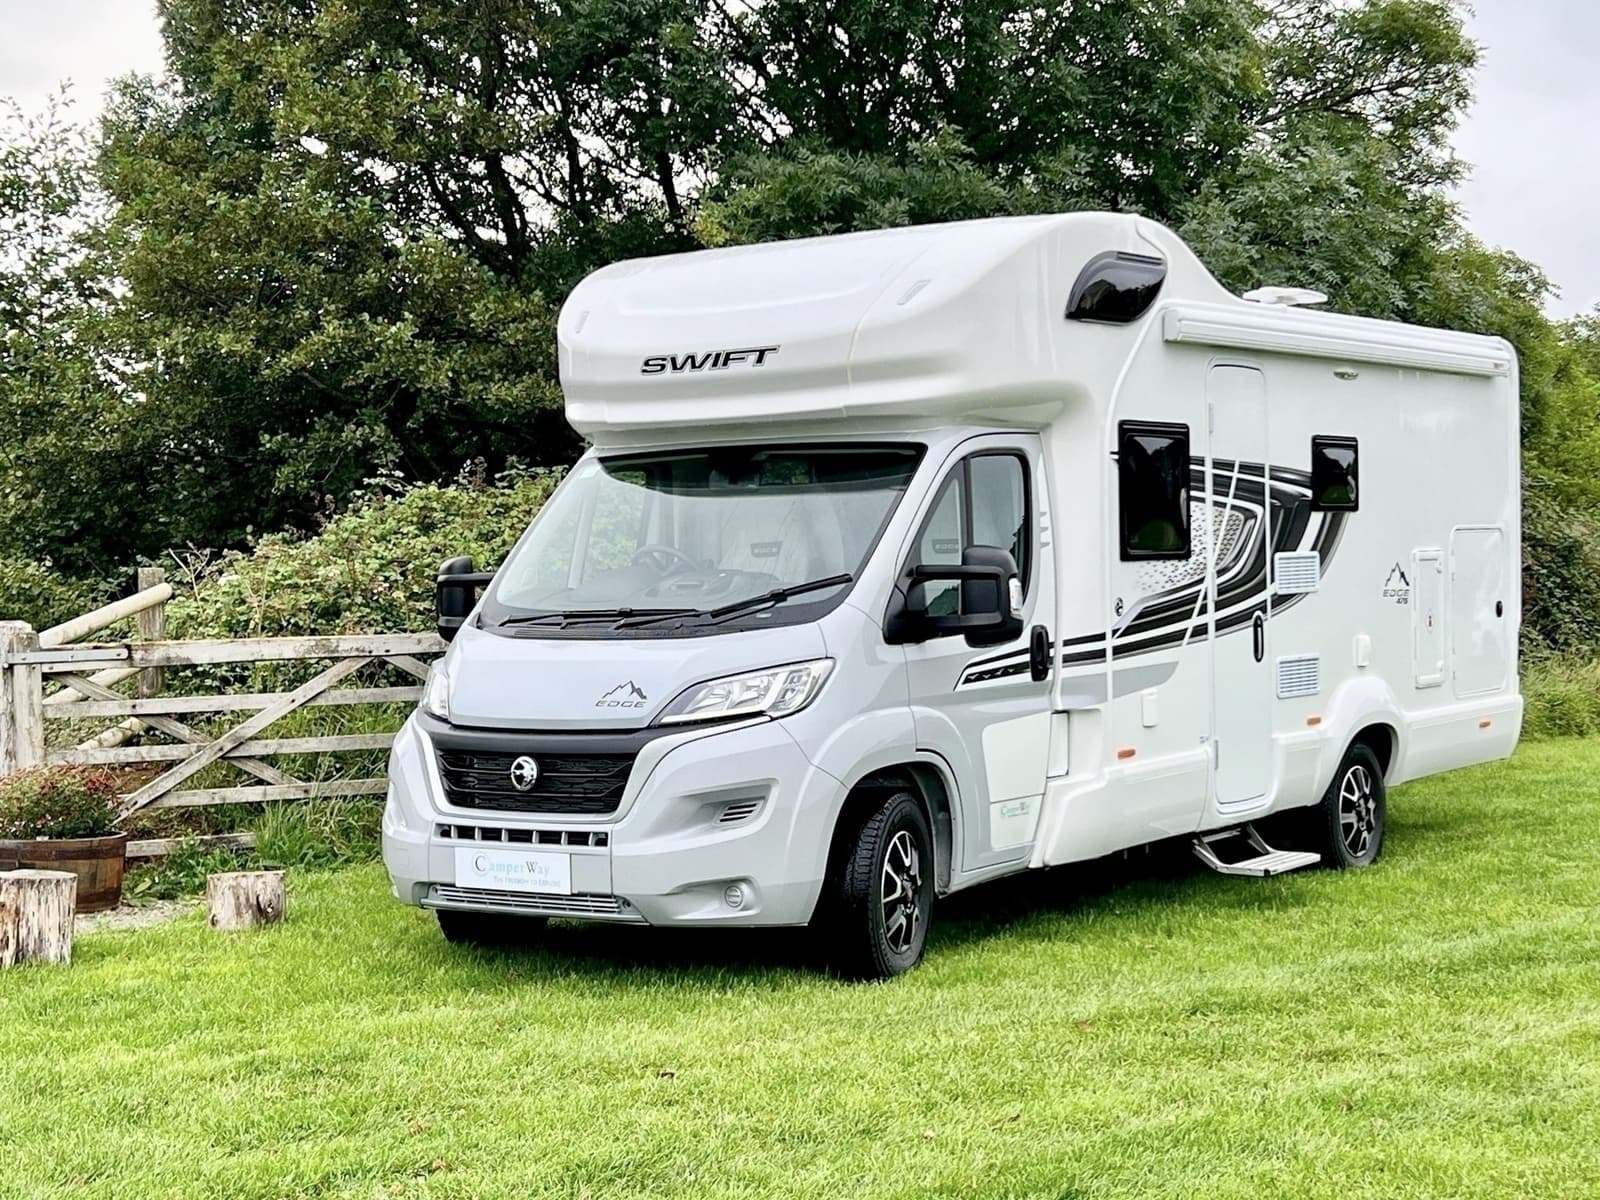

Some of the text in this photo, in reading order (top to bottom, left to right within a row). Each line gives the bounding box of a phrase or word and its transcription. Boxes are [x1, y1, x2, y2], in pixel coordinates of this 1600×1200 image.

[640, 345, 780, 375] SWIFT
[1383, 589, 1411, 598] EDGE
[595, 700, 648, 709] EDGE
